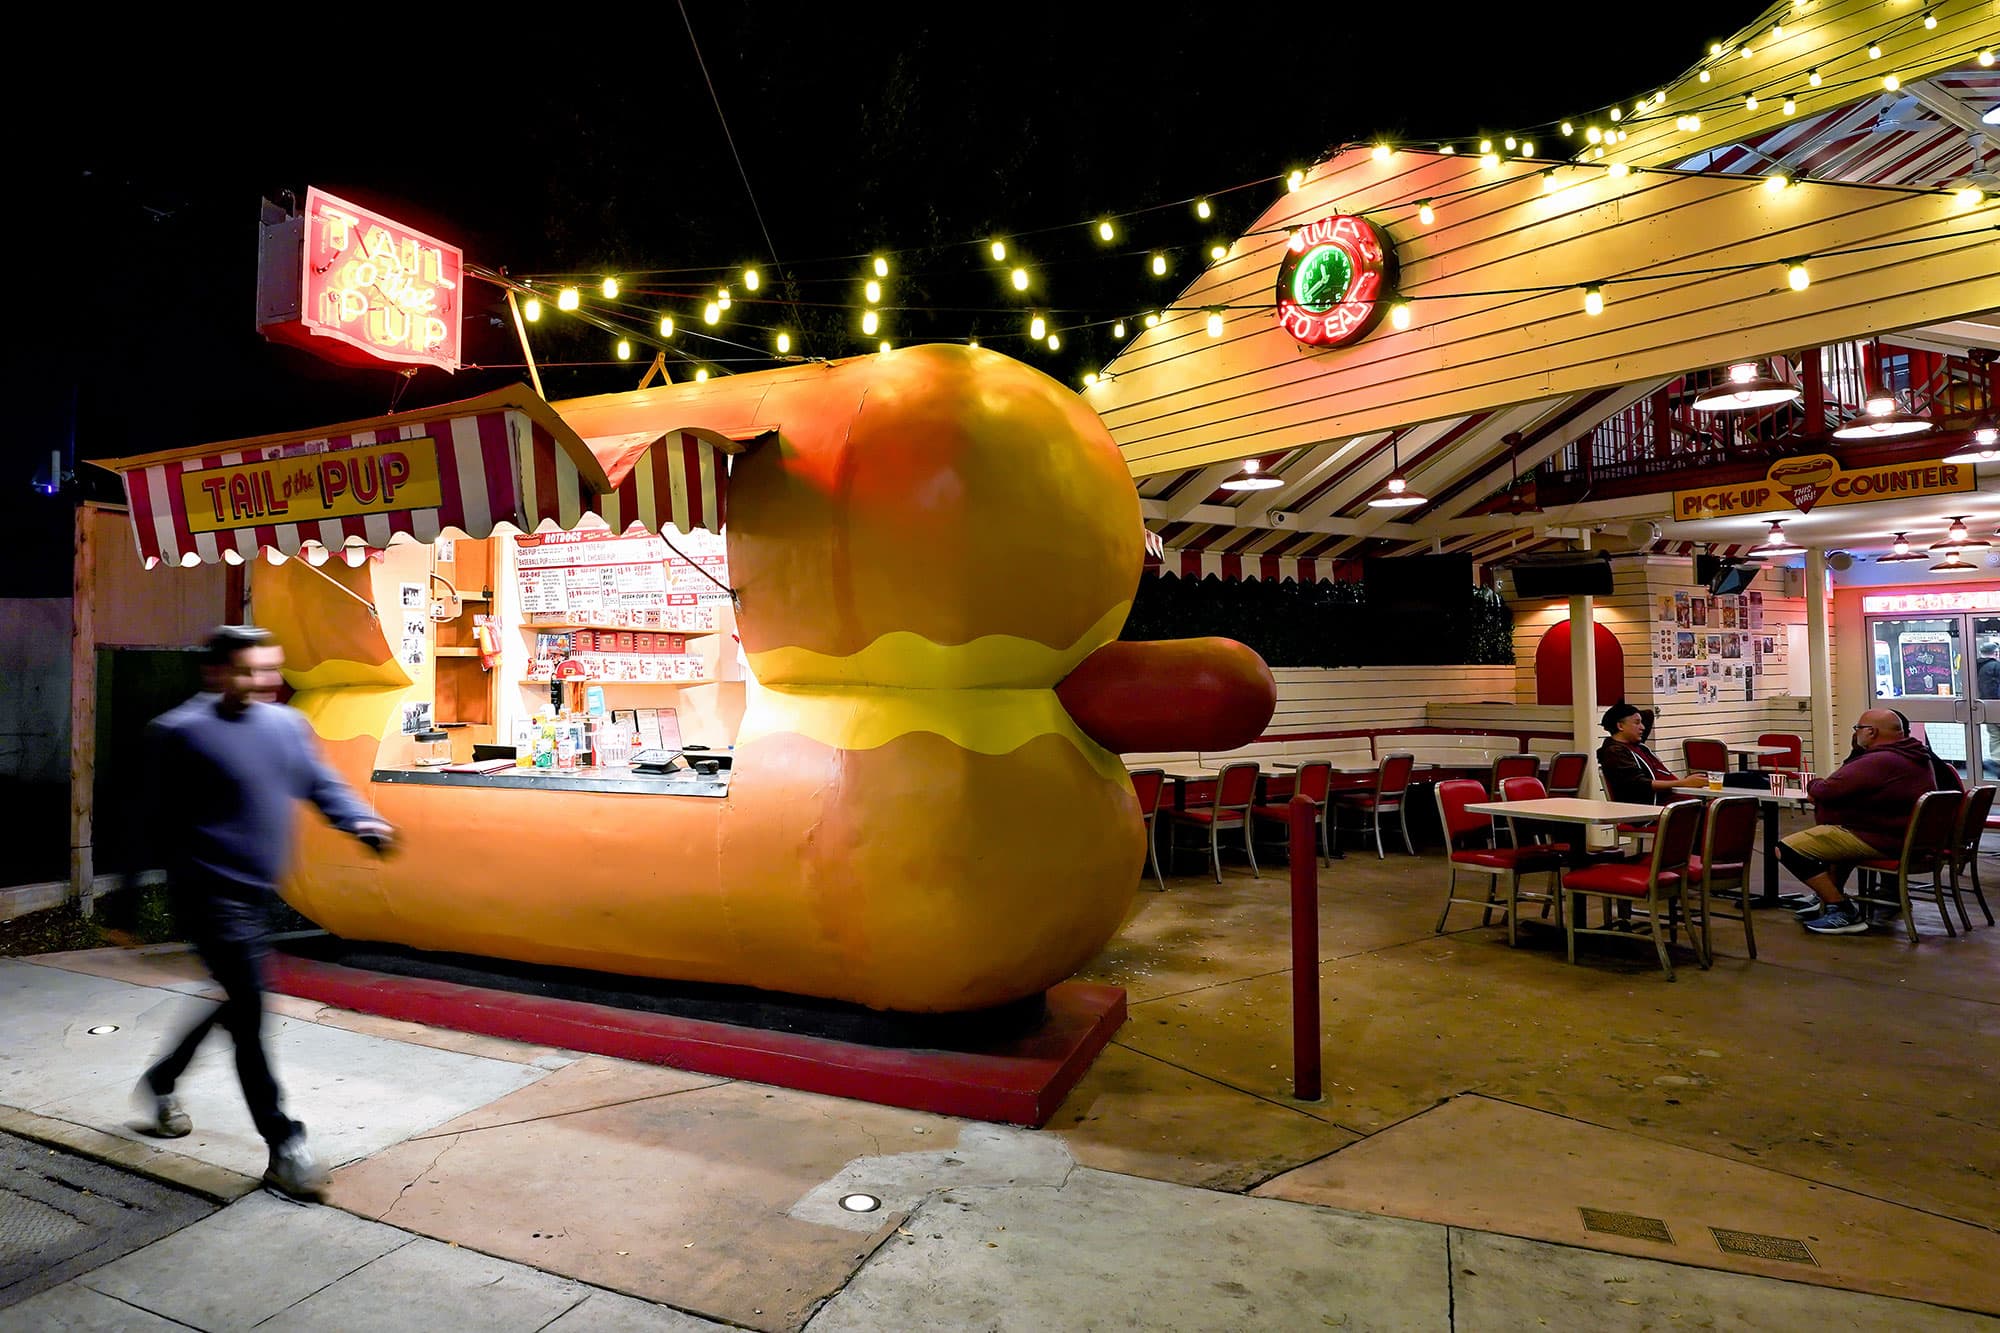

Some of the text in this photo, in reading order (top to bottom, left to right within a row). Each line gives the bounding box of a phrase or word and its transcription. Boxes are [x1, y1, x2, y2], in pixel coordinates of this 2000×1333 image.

[320, 205, 455, 290] TAIL
[320, 287, 447, 352] PUP
[1281, 285, 1369, 338] TO EAT
[202, 471, 288, 521] TAIL
[317, 452, 410, 508] PUP
[1683, 465, 1958, 514] PICK-UP COUNTER
[1793, 485, 1813, 497] THIS
[1795, 490, 1817, 505] WAY!
[545, 532, 582, 543] HOTDOGS
